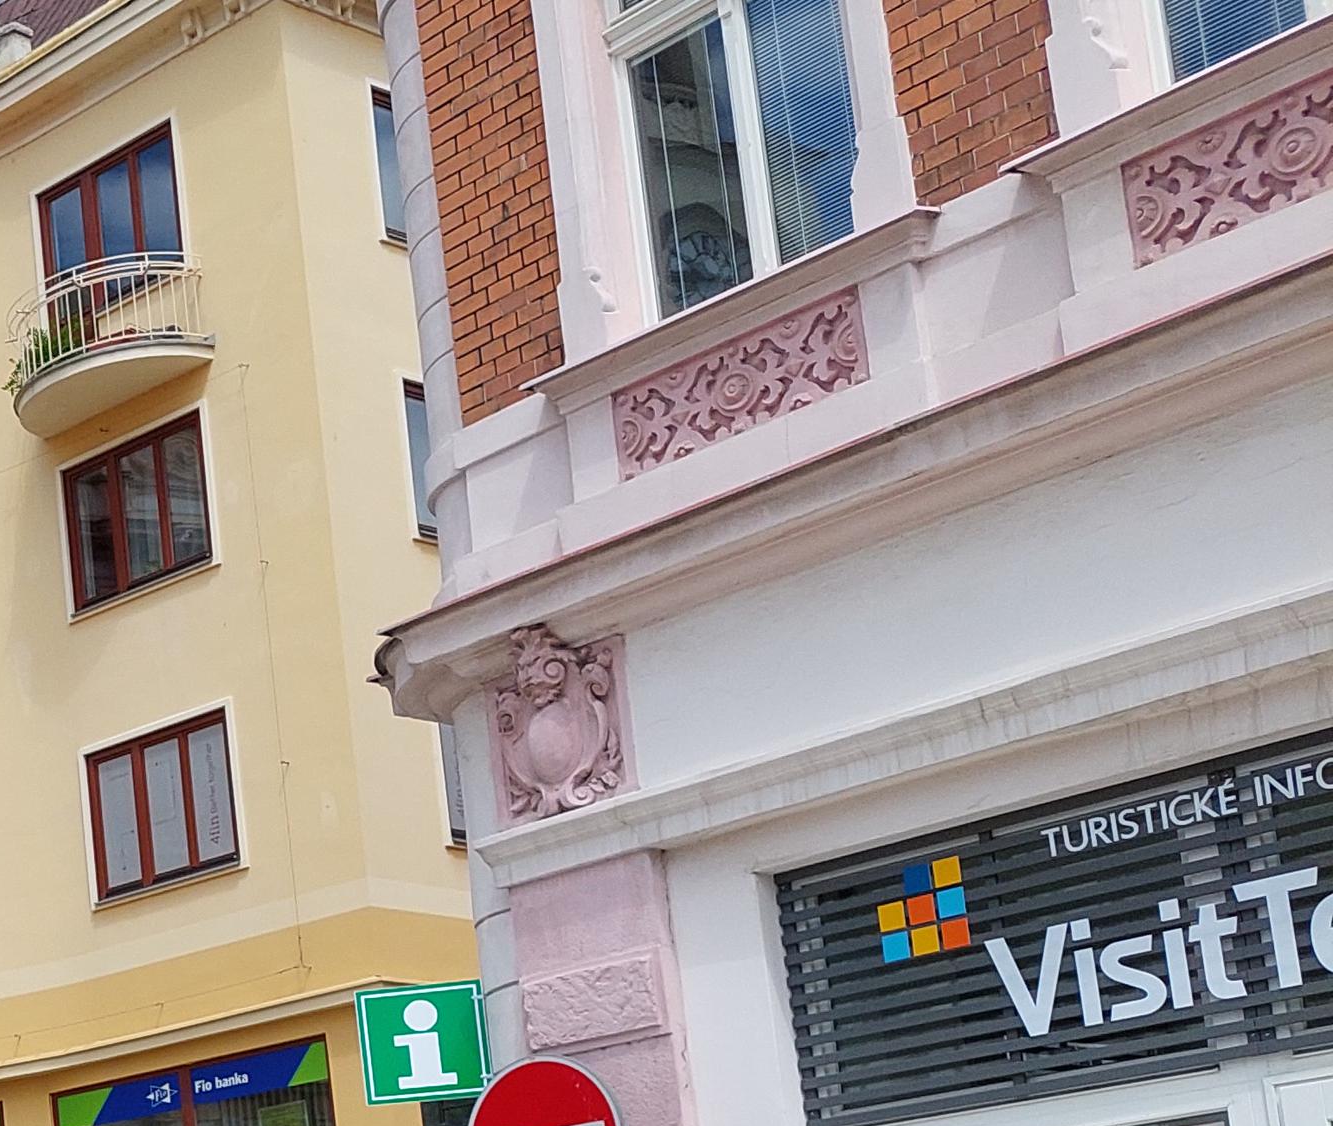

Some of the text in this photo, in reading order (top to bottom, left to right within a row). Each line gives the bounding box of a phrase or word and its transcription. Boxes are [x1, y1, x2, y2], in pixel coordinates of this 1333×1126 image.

[1040, 777, 1238, 858] TURISTICKÉ
[194, 1072, 249, 1094] Fio banka
